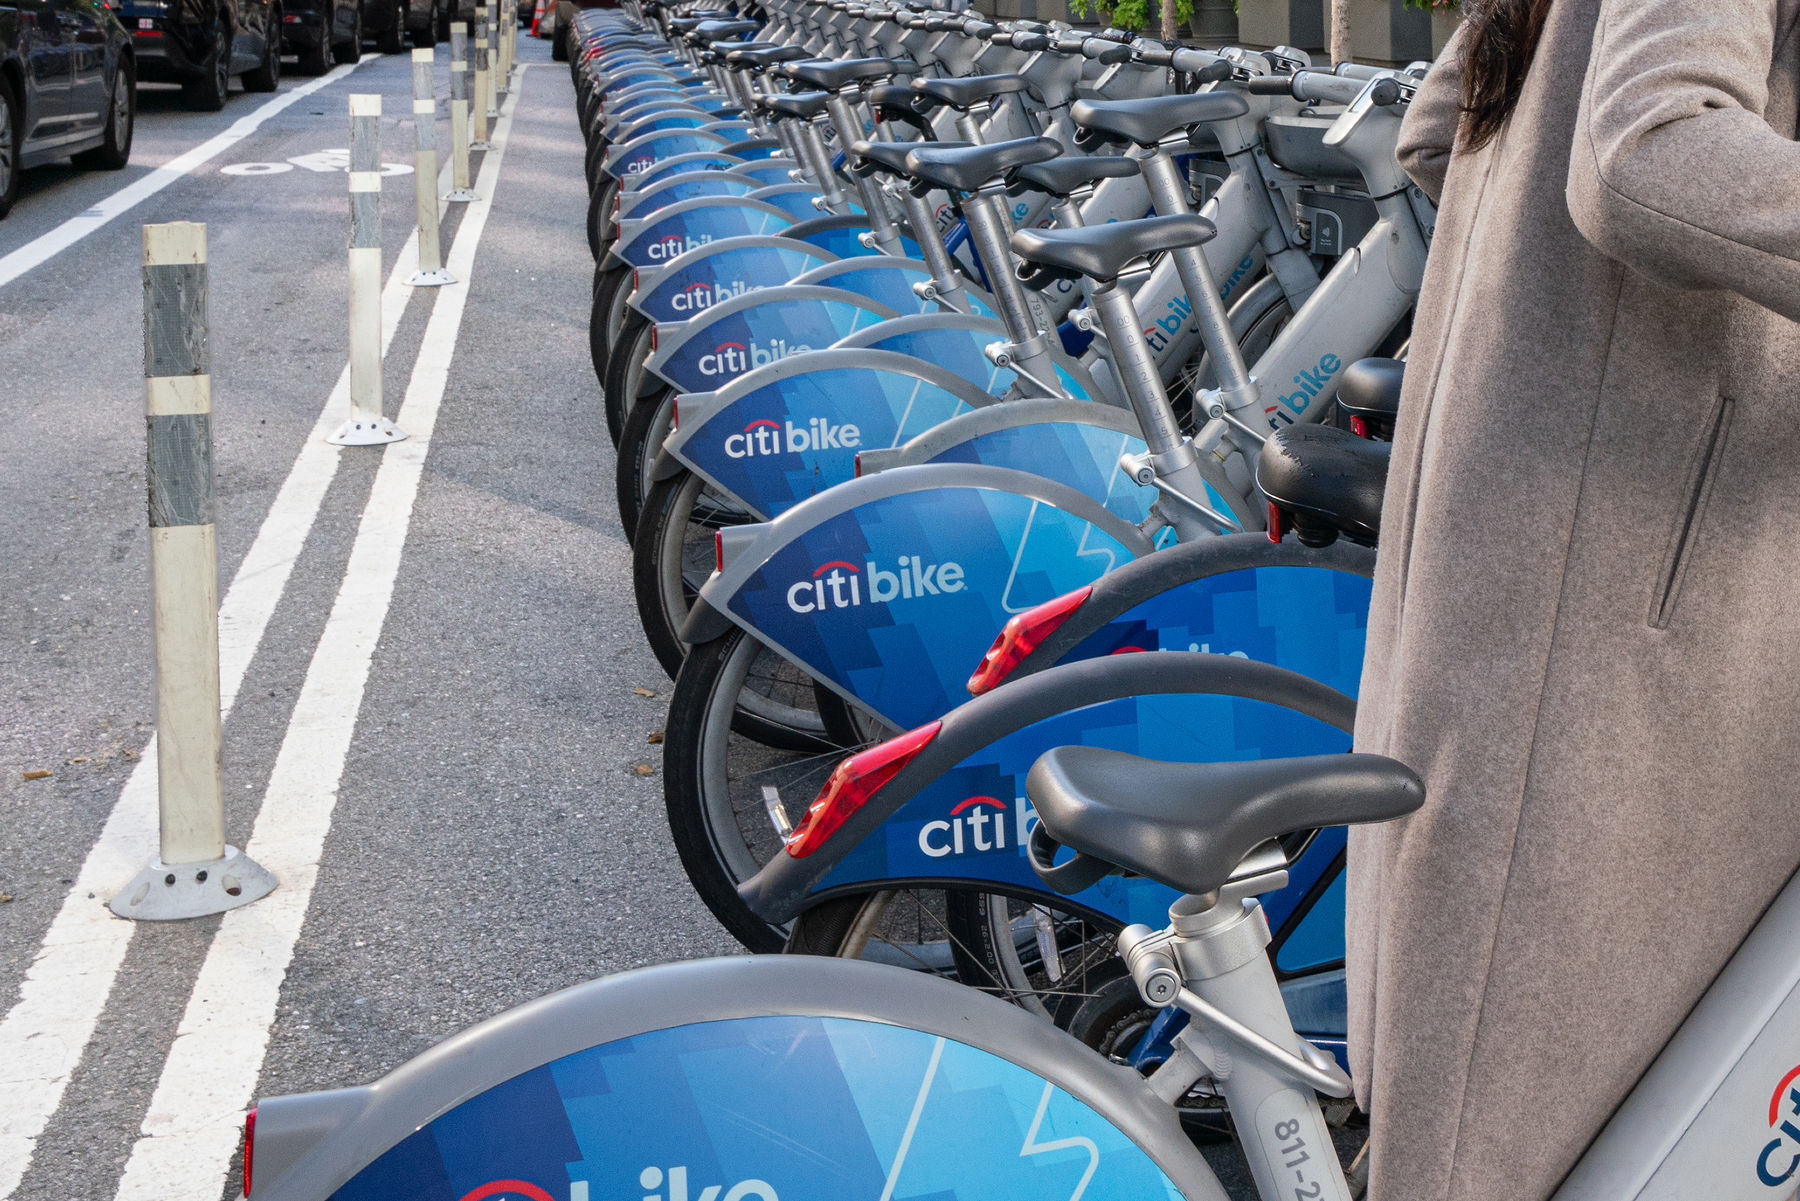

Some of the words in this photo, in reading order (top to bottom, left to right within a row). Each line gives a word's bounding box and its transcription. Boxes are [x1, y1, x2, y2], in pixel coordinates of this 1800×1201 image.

[648, 235, 683, 259] citi
[671, 283, 712, 311] citi
[1157, 294, 1192, 336] bik
[698, 342, 746, 376] citi
[1278, 353, 1341, 415] bike
[724, 419, 781, 458] citi
[785, 418, 861, 453] bike
[787, 561, 861, 613] citi
[867, 556, 966, 603] bike
[918, 795, 1007, 858] citi
[1274, 1118, 1326, 1201] 811-2
